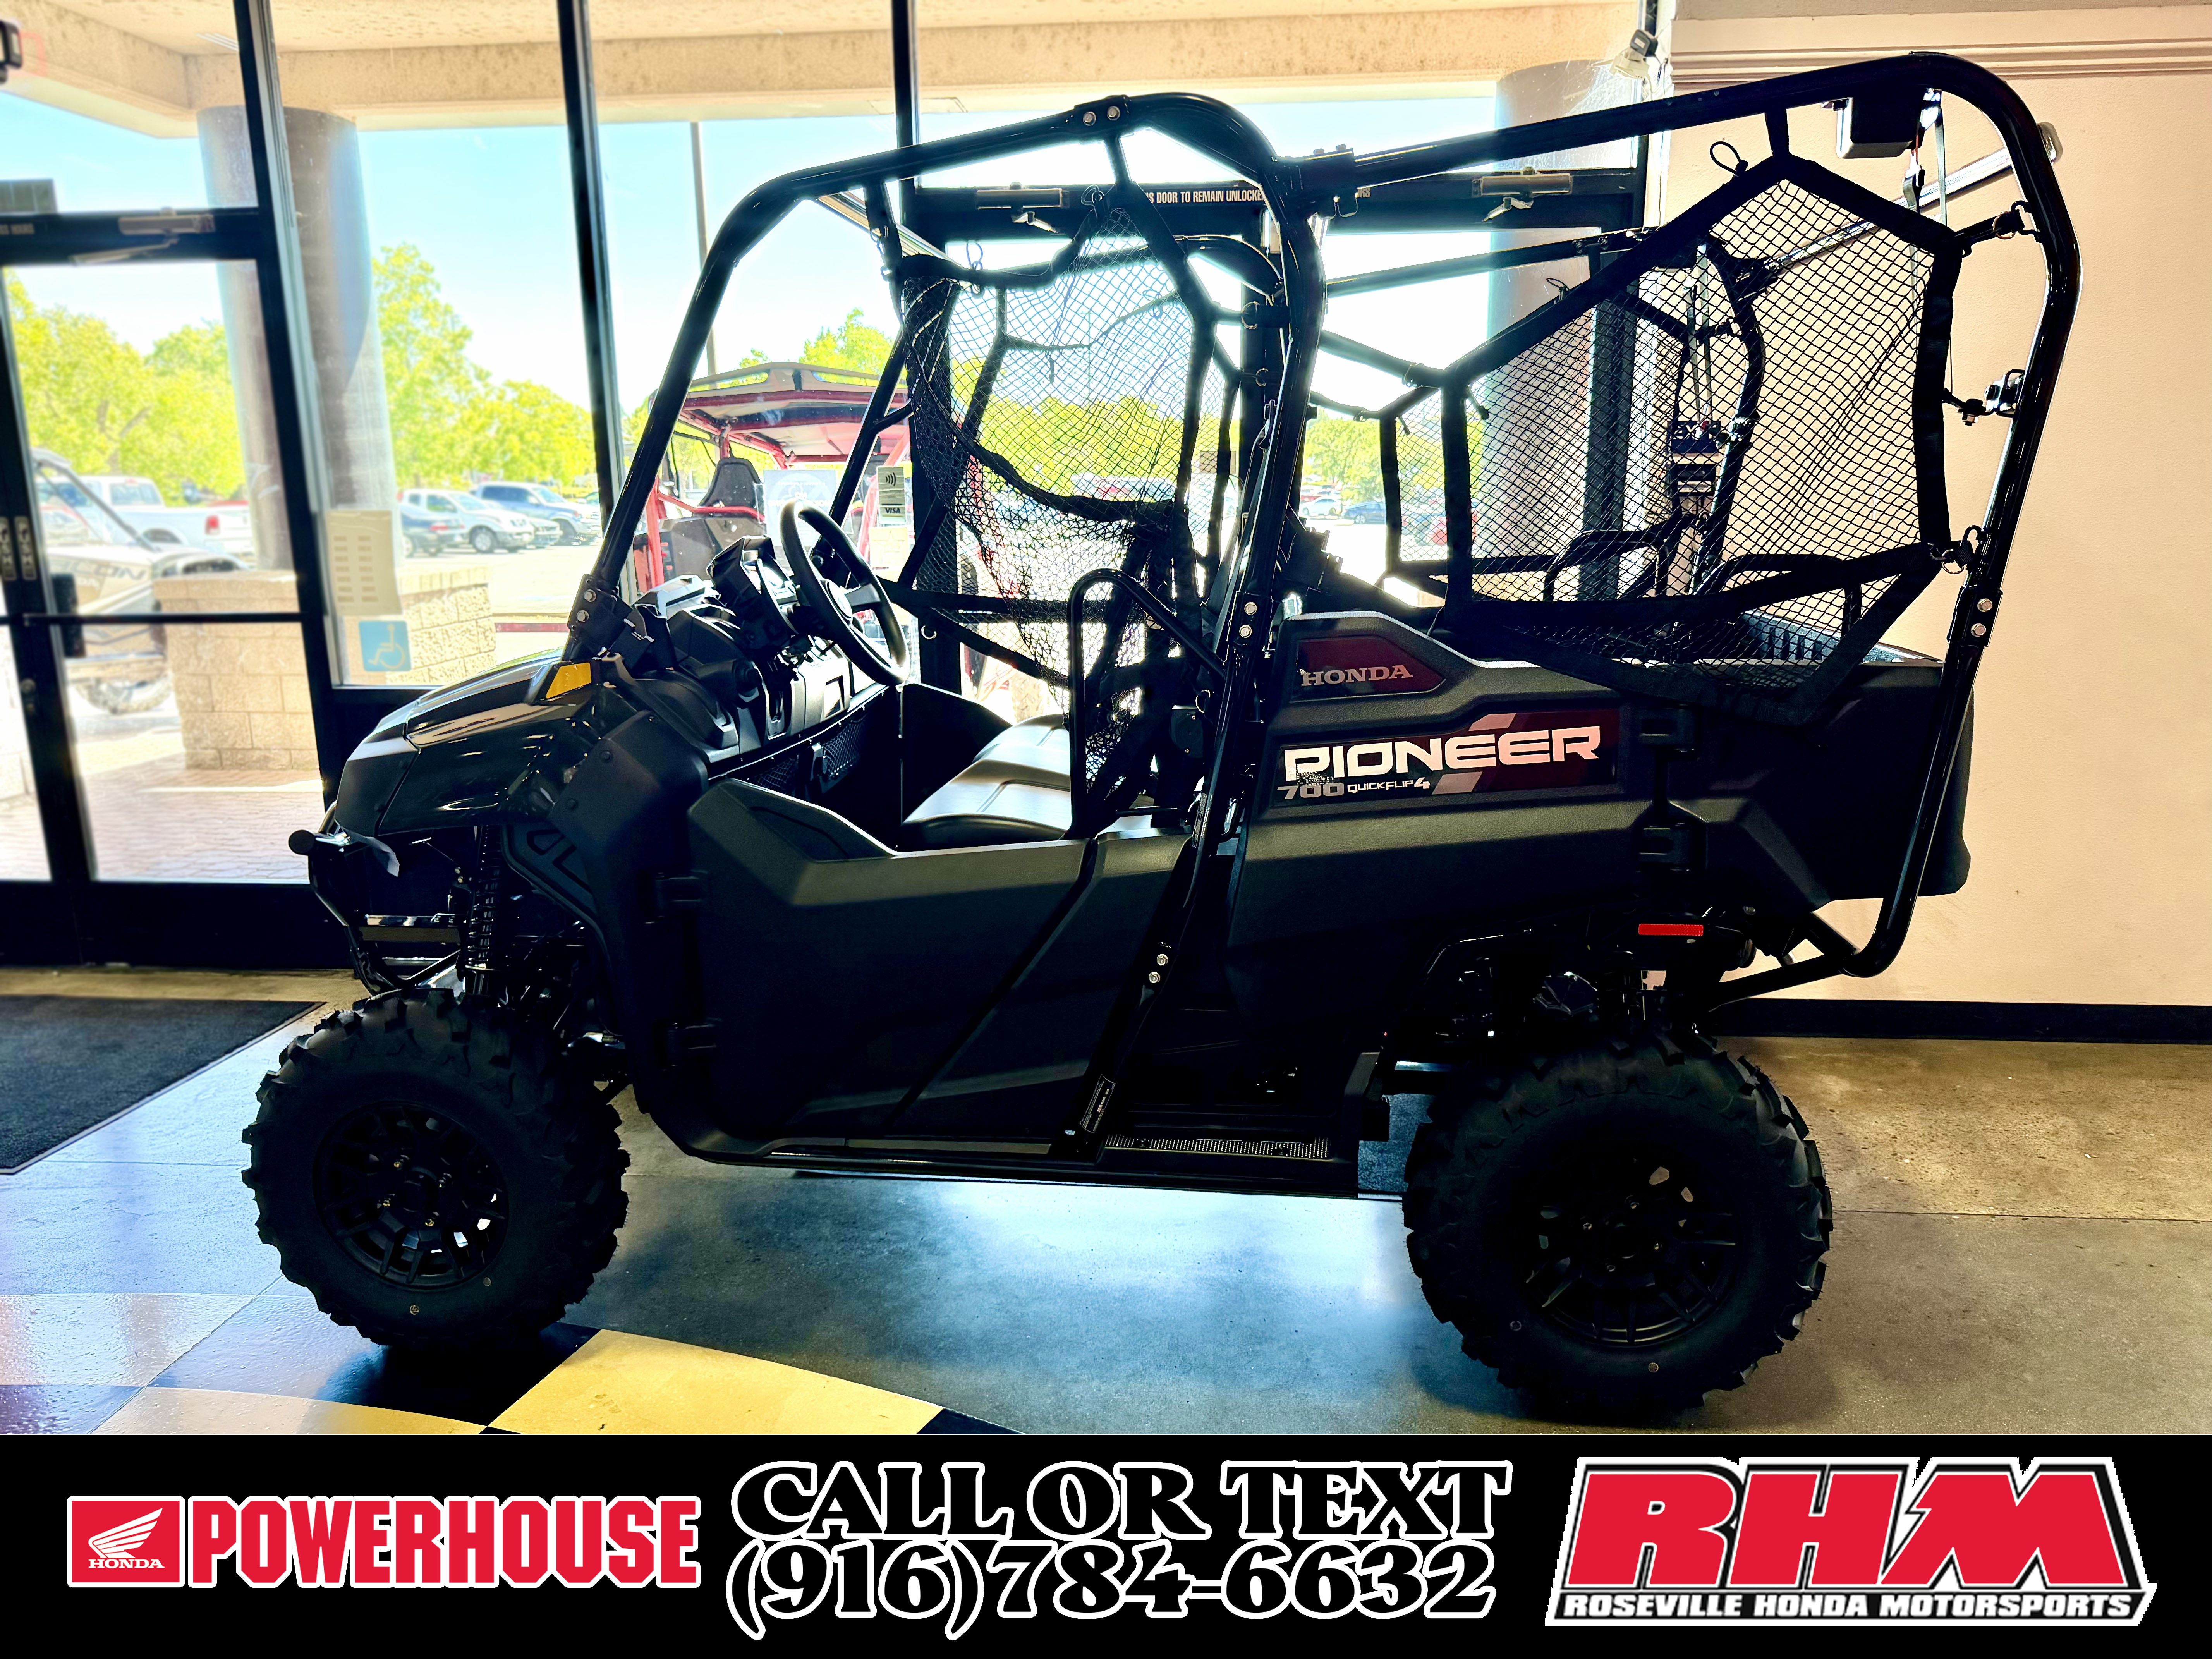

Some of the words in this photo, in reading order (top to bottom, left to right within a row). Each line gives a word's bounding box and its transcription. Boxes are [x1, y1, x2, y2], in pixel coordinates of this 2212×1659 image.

[1156, 192, 1178, 203] DOOR
[1181, 192, 1190, 203] TO
[1193, 191, 1224, 203] REMAIN
[1226, 189, 1264, 201] UNLOCKE
[1300, 665, 1413, 686] HONDA
[1284, 726, 1601, 782] PIONEER
[1277, 782, 1345, 799] 700
